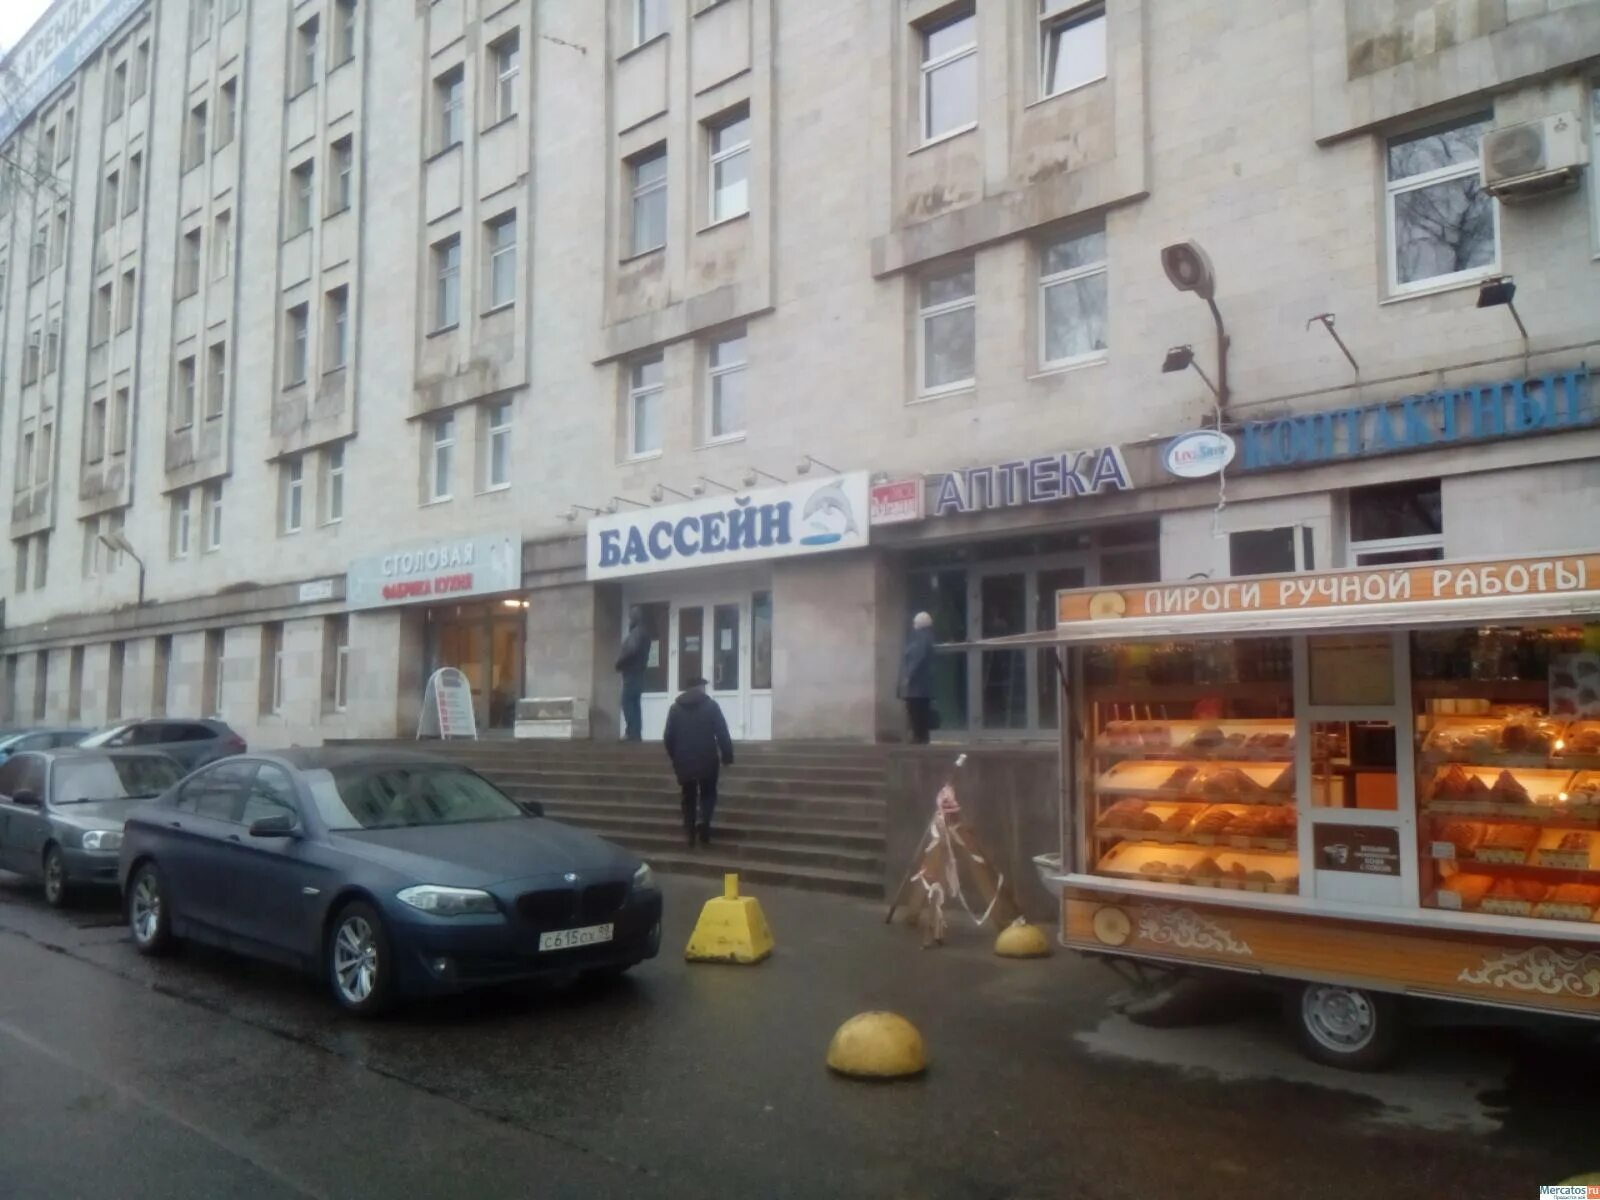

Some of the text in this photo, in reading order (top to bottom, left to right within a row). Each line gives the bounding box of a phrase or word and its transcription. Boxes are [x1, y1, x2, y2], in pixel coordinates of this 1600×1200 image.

[934, 444, 1133, 517] АПТЕКА
[383, 543, 474, 577] СТОЛОВАЯ
[598, 495, 793, 567] БАССЕЙН
[1144, 559, 1586, 614] ПИРОГИ РУЧНОЙ РАБОТЫ
